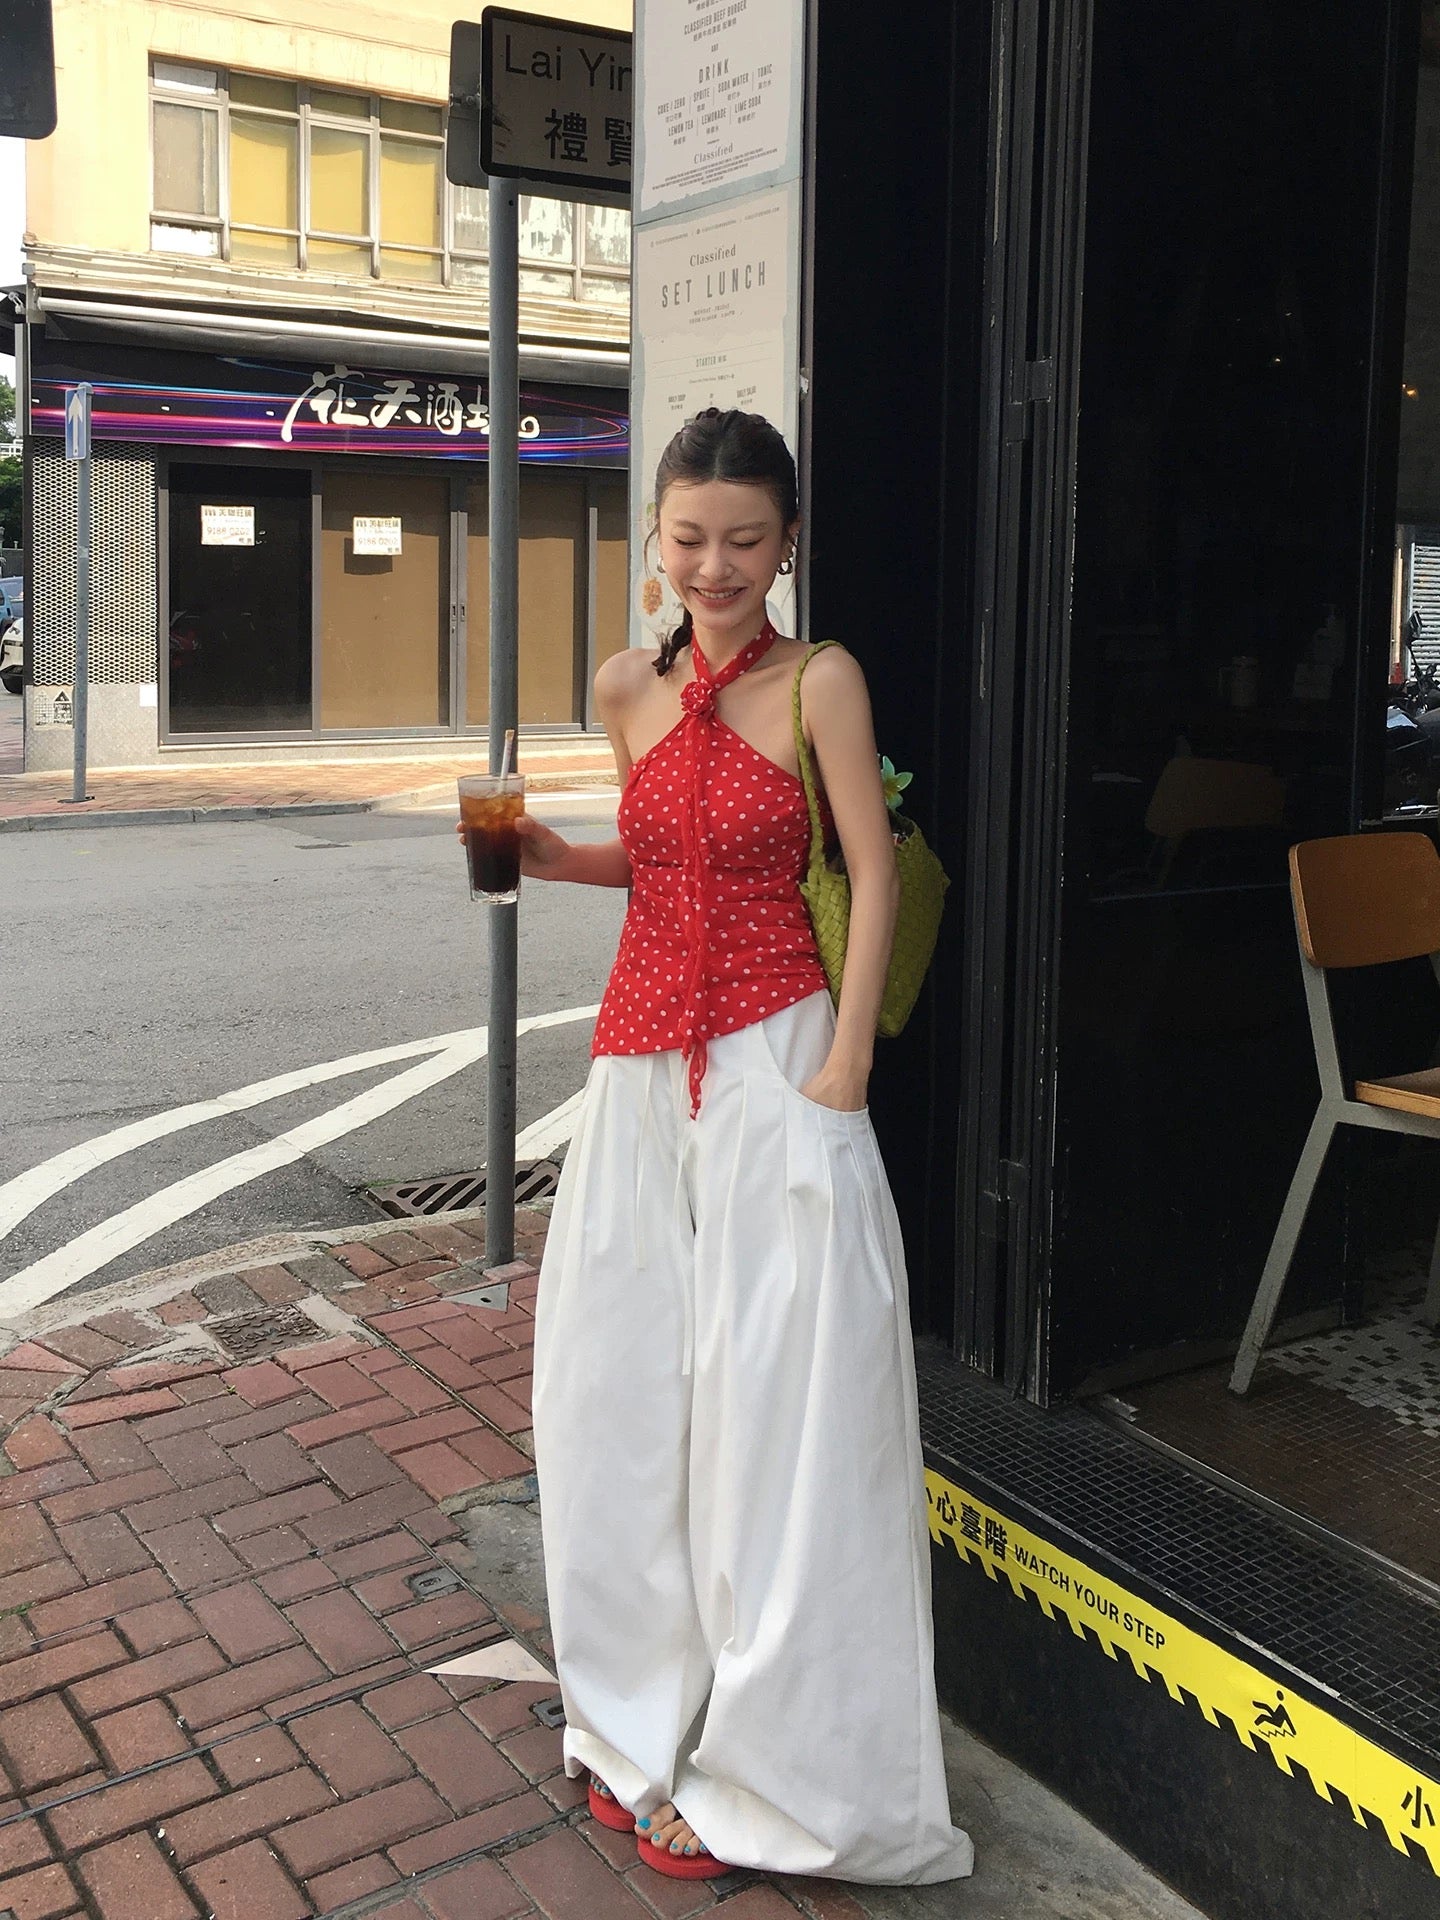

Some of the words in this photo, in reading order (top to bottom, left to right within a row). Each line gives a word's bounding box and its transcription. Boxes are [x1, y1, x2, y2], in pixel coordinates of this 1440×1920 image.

[684, 14, 712, 35] CLASSIFIED
[505, 34, 561, 81] Lai
[699, 58, 729, 84] DRINK
[757, 63, 772, 78] TONIC
[718, 80, 731, 93] SODA
[732, 72, 749, 87] WATER
[657, 102, 670, 115] COKE
[674, 97, 686, 110] ZERO
[693, 88, 710, 103] SPRITE
[734, 100, 747, 114] LIME
[748, 95, 761, 109] SODA
[701, 107, 726, 126] LEMONADE
[668, 123, 684, 137] LEMON
[685, 119, 694, 132] TEA
[694, 142, 733, 164] Classified
[689, 243, 736, 267] Classified
[662, 279, 692, 308] SET
[707, 260, 765, 298] LUNCH
[926, 1486, 1008, 1562] 心臺階
[1014, 1544, 1069, 1593] WATCH
[1073, 1580, 1119, 1624] YOUR
[1123, 1613, 1165, 1650] STEP
[1401, 1785, 1436, 1829] 小
